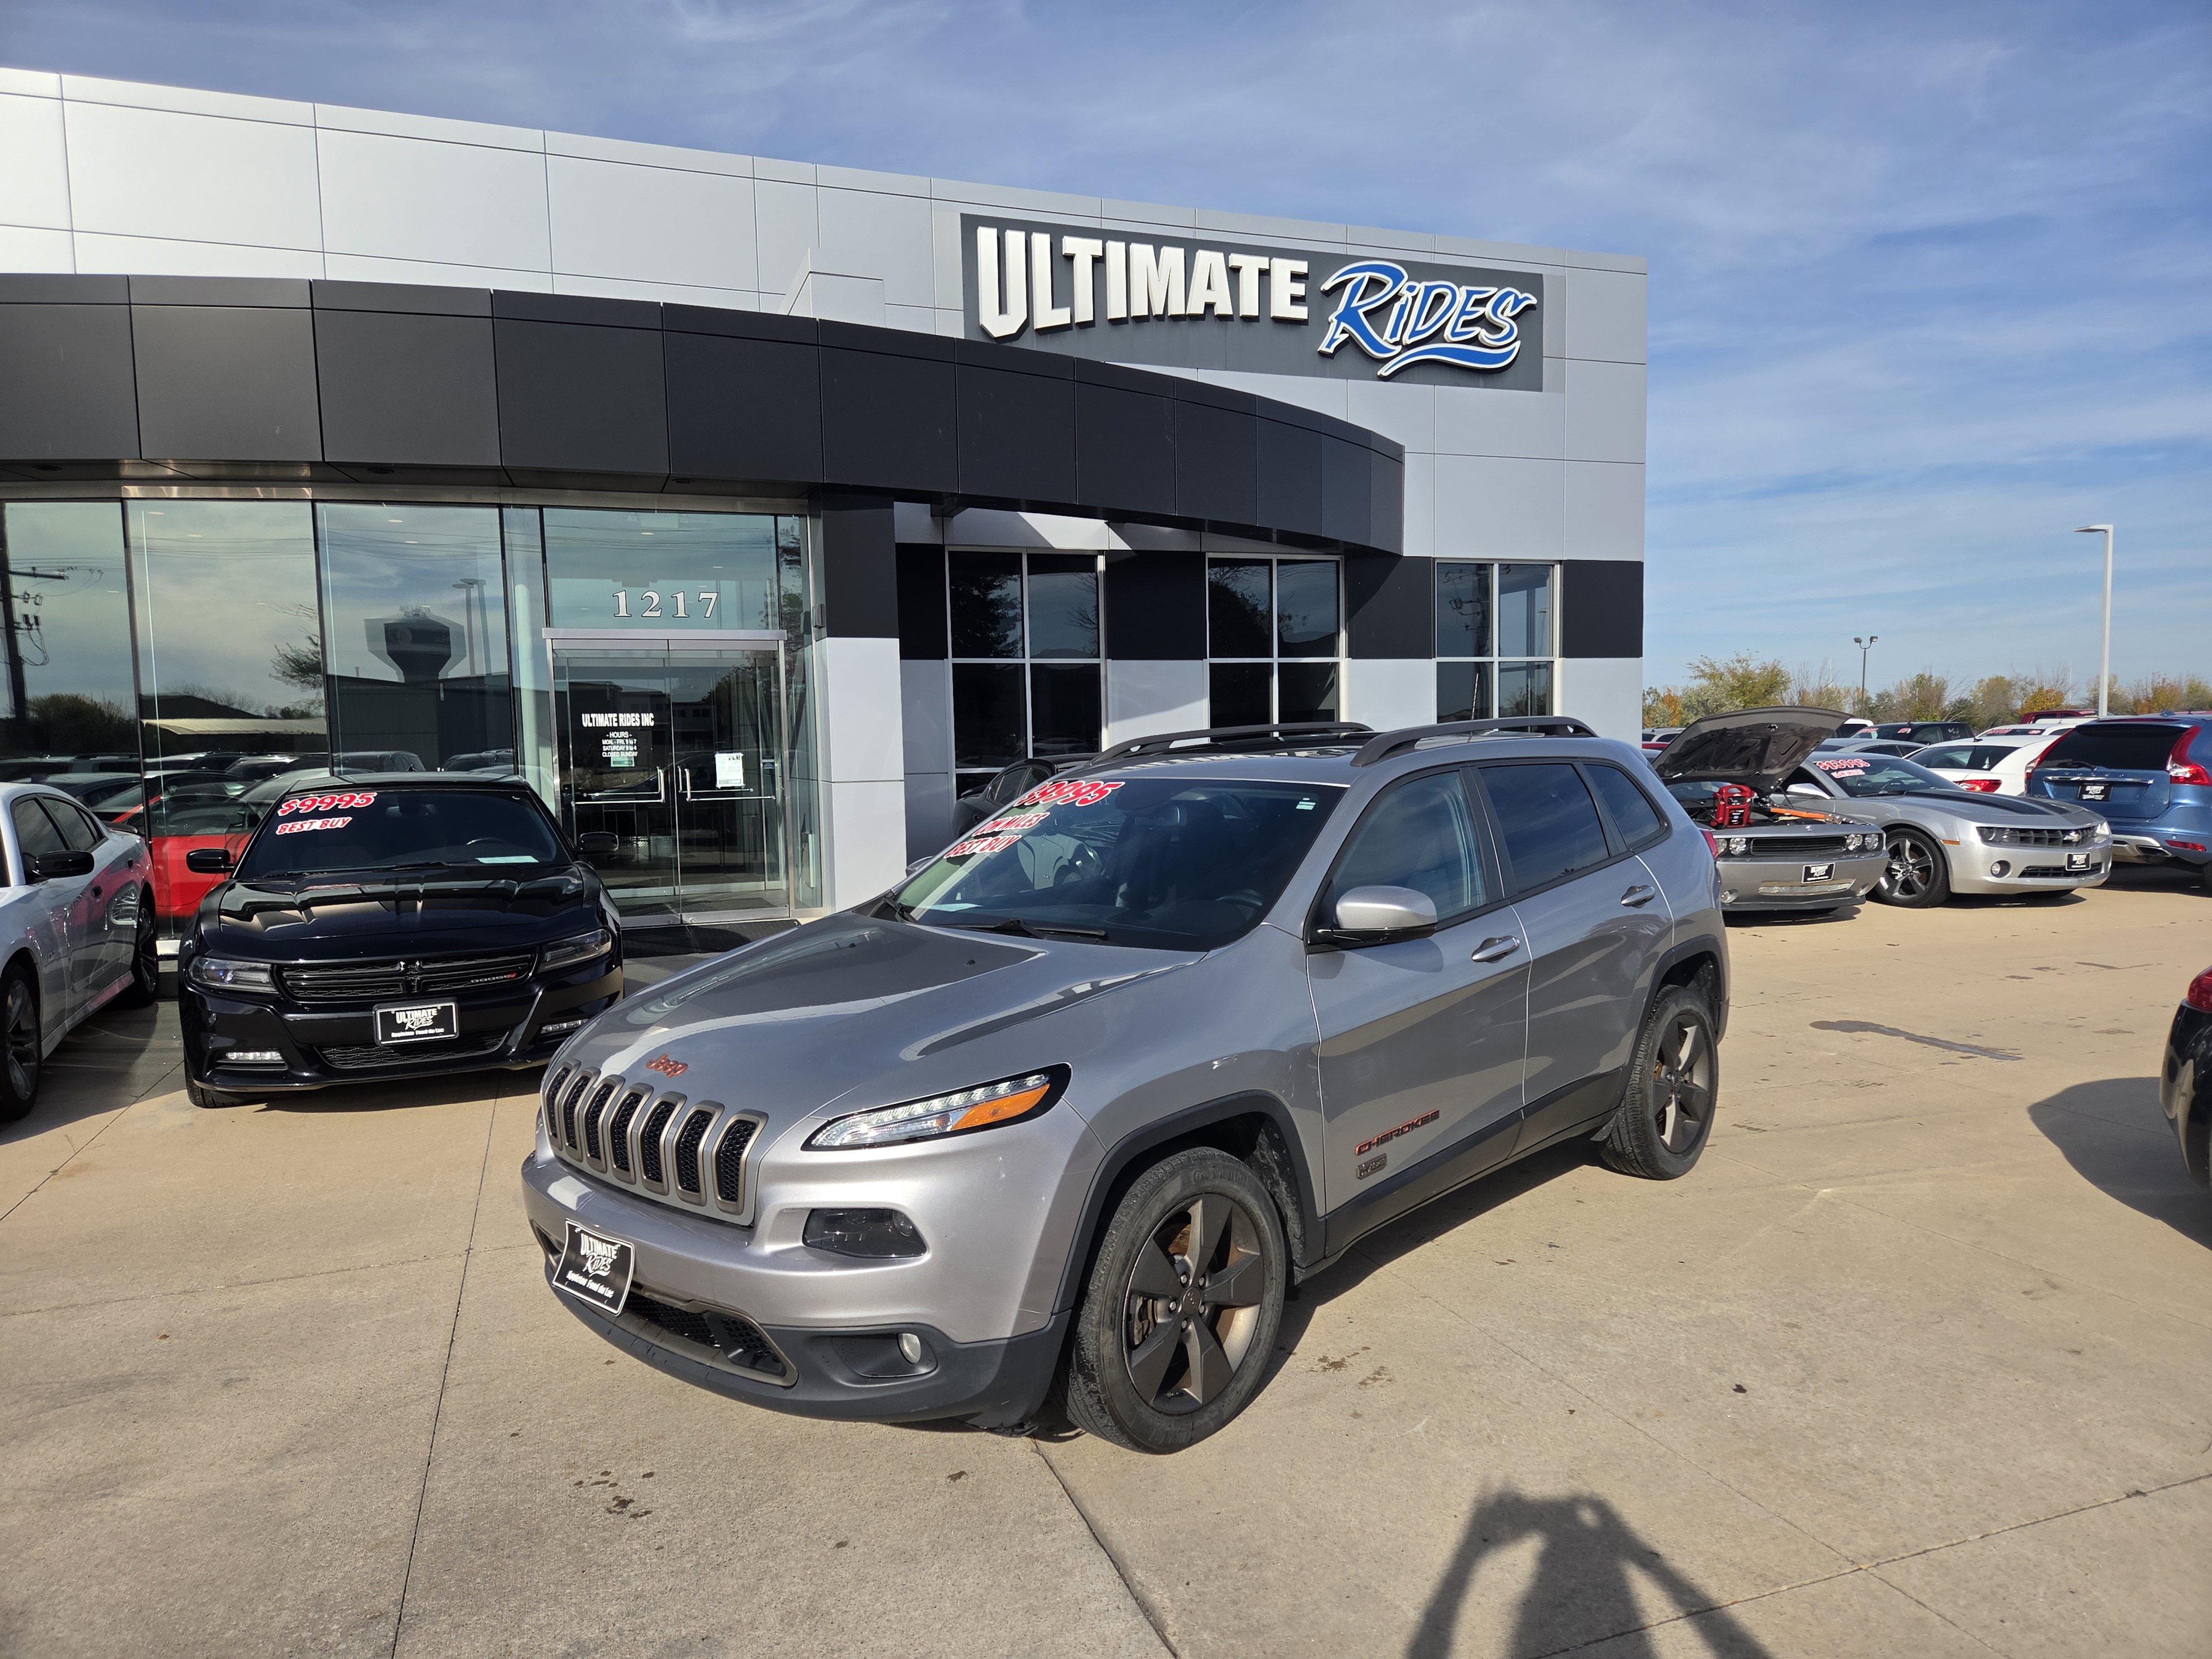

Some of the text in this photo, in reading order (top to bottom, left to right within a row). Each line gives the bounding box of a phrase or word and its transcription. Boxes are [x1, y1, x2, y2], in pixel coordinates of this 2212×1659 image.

[977, 226, 1310, 339] ULTIMATE
[613, 590, 718, 618] 1217
[582, 713, 654, 727] ULTIMATE RIDES INC
[278, 792, 378, 816] $9995
[1013, 781, 1125, 806] $9995
[276, 817, 353, 835] BEST BUY
[943, 835, 1022, 859] BEST BUY
[471, 975, 510, 983] DODGE
[395, 1008, 438, 1024] ULTIMATE
[646, 1053, 688, 1078] Jeep
[1355, 1108, 1440, 1156] CHEROKEE
[581, 1234, 618, 1259] ULTIMATE
